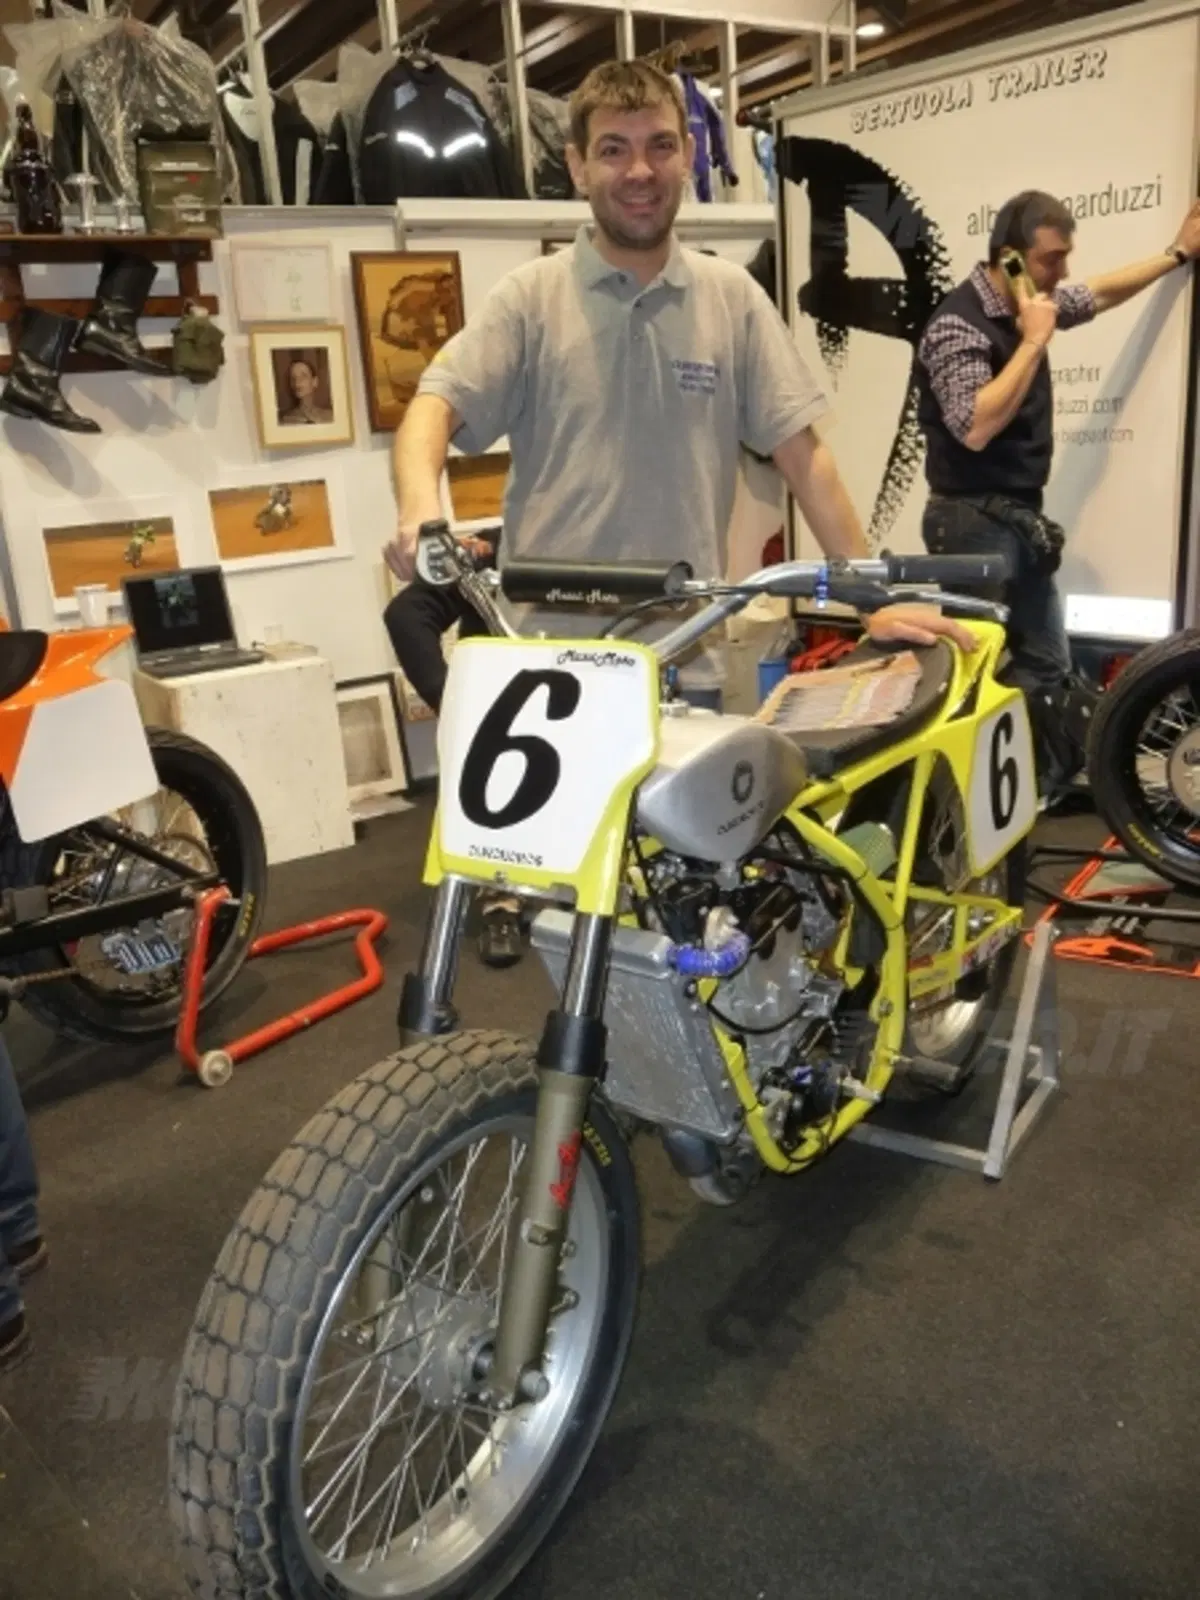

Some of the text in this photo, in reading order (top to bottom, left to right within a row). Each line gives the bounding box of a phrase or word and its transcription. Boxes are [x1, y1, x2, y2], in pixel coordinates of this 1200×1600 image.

[850, 46, 1108, 135] BERTUOLA TRAILER
[458, 668, 581, 830] 6
[989, 711, 1019, 832] 6
